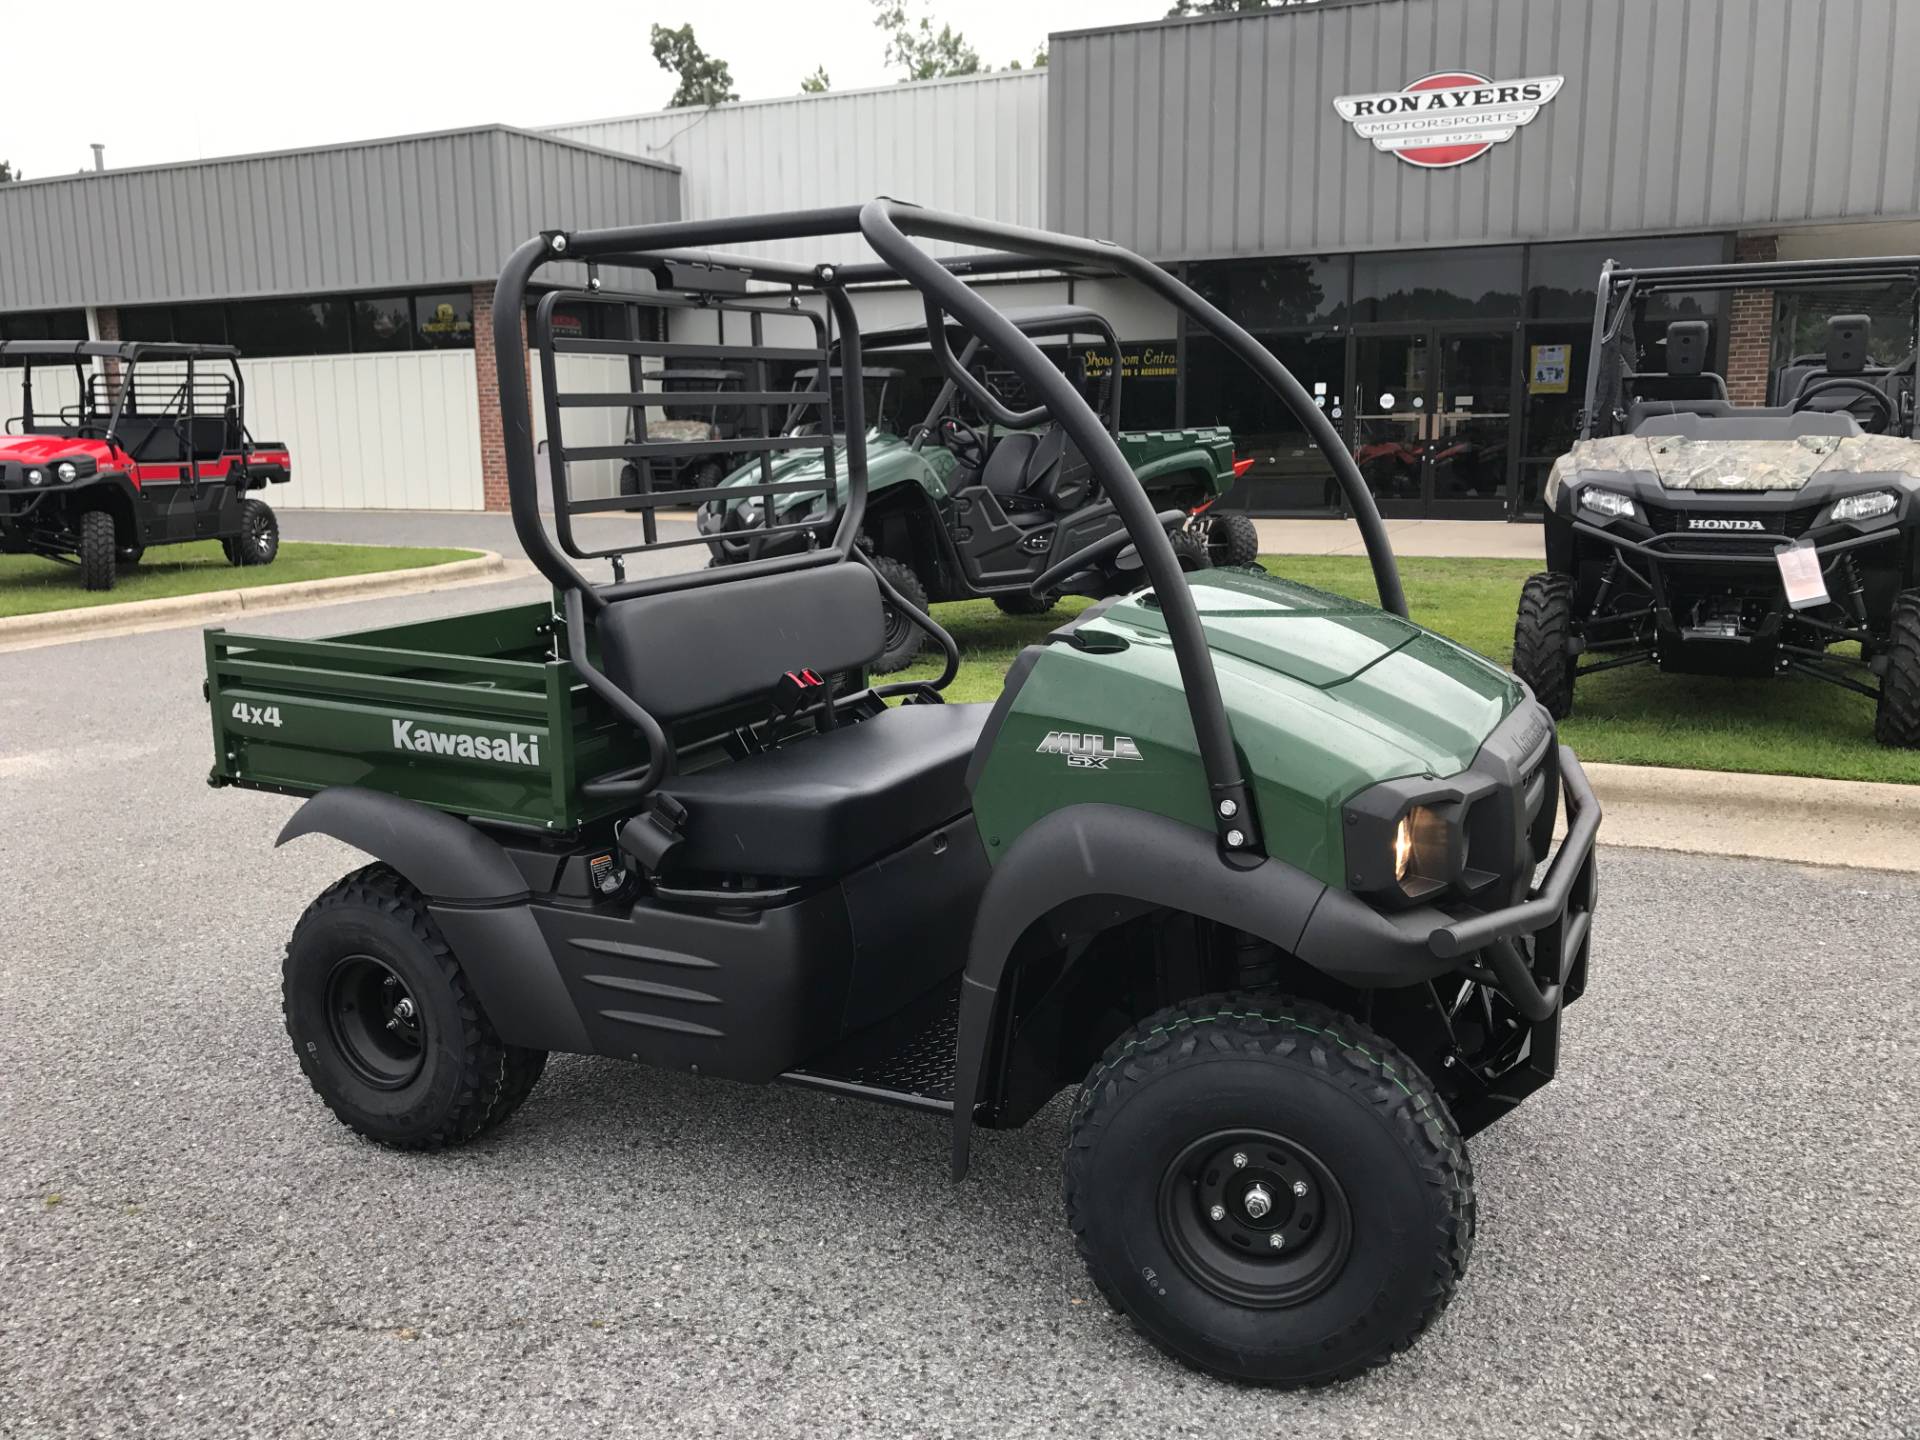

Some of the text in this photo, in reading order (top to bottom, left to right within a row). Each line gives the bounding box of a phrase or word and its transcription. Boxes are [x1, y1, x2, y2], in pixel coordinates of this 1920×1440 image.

[1353, 83, 1542, 116] RON AYERS
[1370, 111, 1520, 133] MOTORSPORTS
[1688, 519, 1765, 530] HONDA
[231, 701, 283, 728] 4x4
[391, 719, 540, 766] Kawasaki
[1035, 731, 1144, 760] MULE
[1067, 754, 1109, 769] SX
